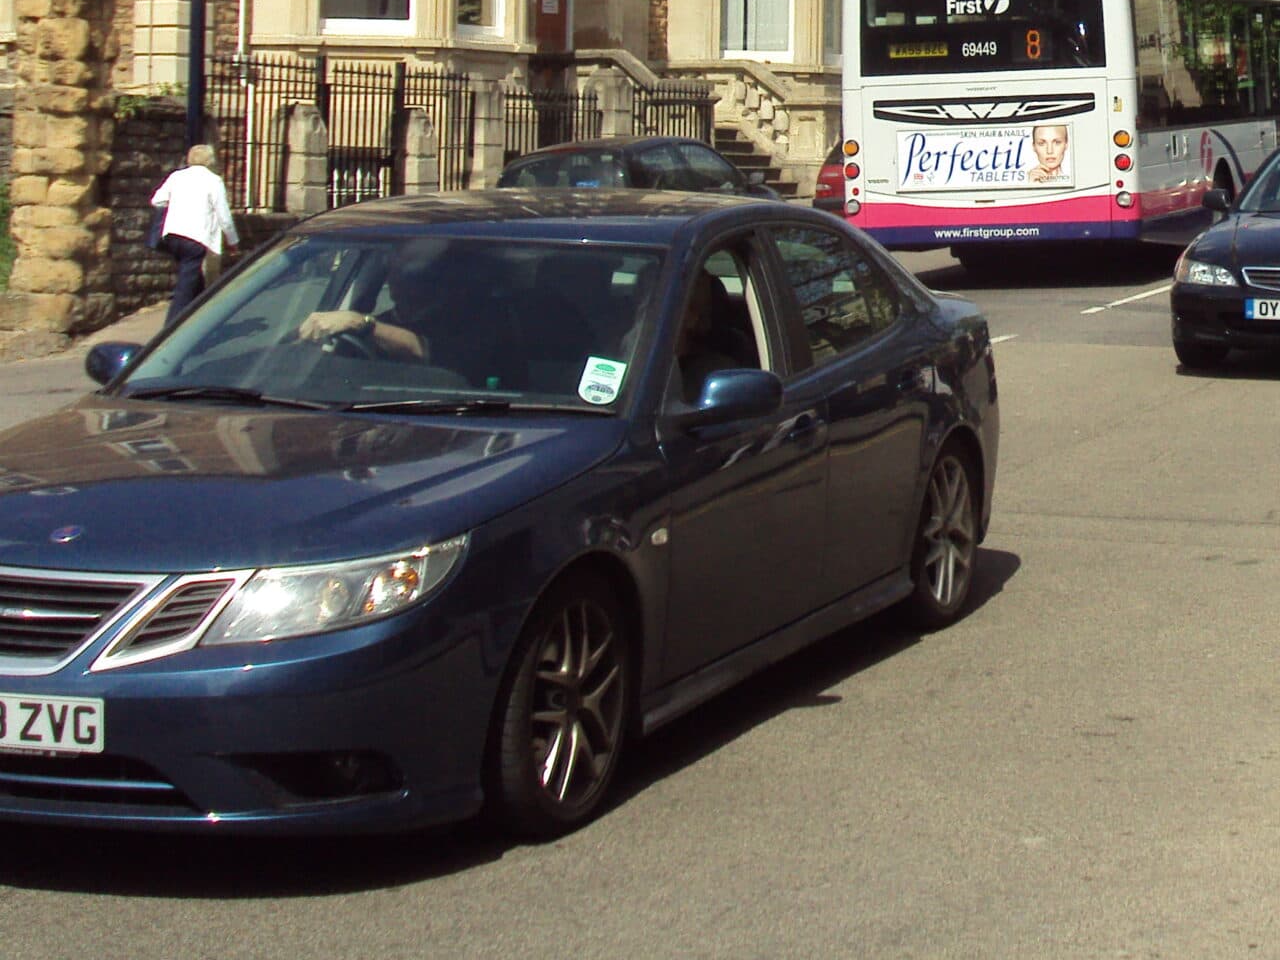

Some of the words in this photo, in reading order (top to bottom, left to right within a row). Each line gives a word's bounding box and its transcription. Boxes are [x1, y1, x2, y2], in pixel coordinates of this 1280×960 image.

[962, 42, 997, 56] 69449
[1026, 30, 1041, 60] 8
[979, 130, 997, 138] HAIR
[1006, 129, 1026, 137] NAILS
[902, 133, 1030, 186] Perfectil
[970, 171, 1025, 182] TABLETS
[935, 227, 1039, 239] www.firstgroup.com
[20, 701, 97, 745] ZVG
